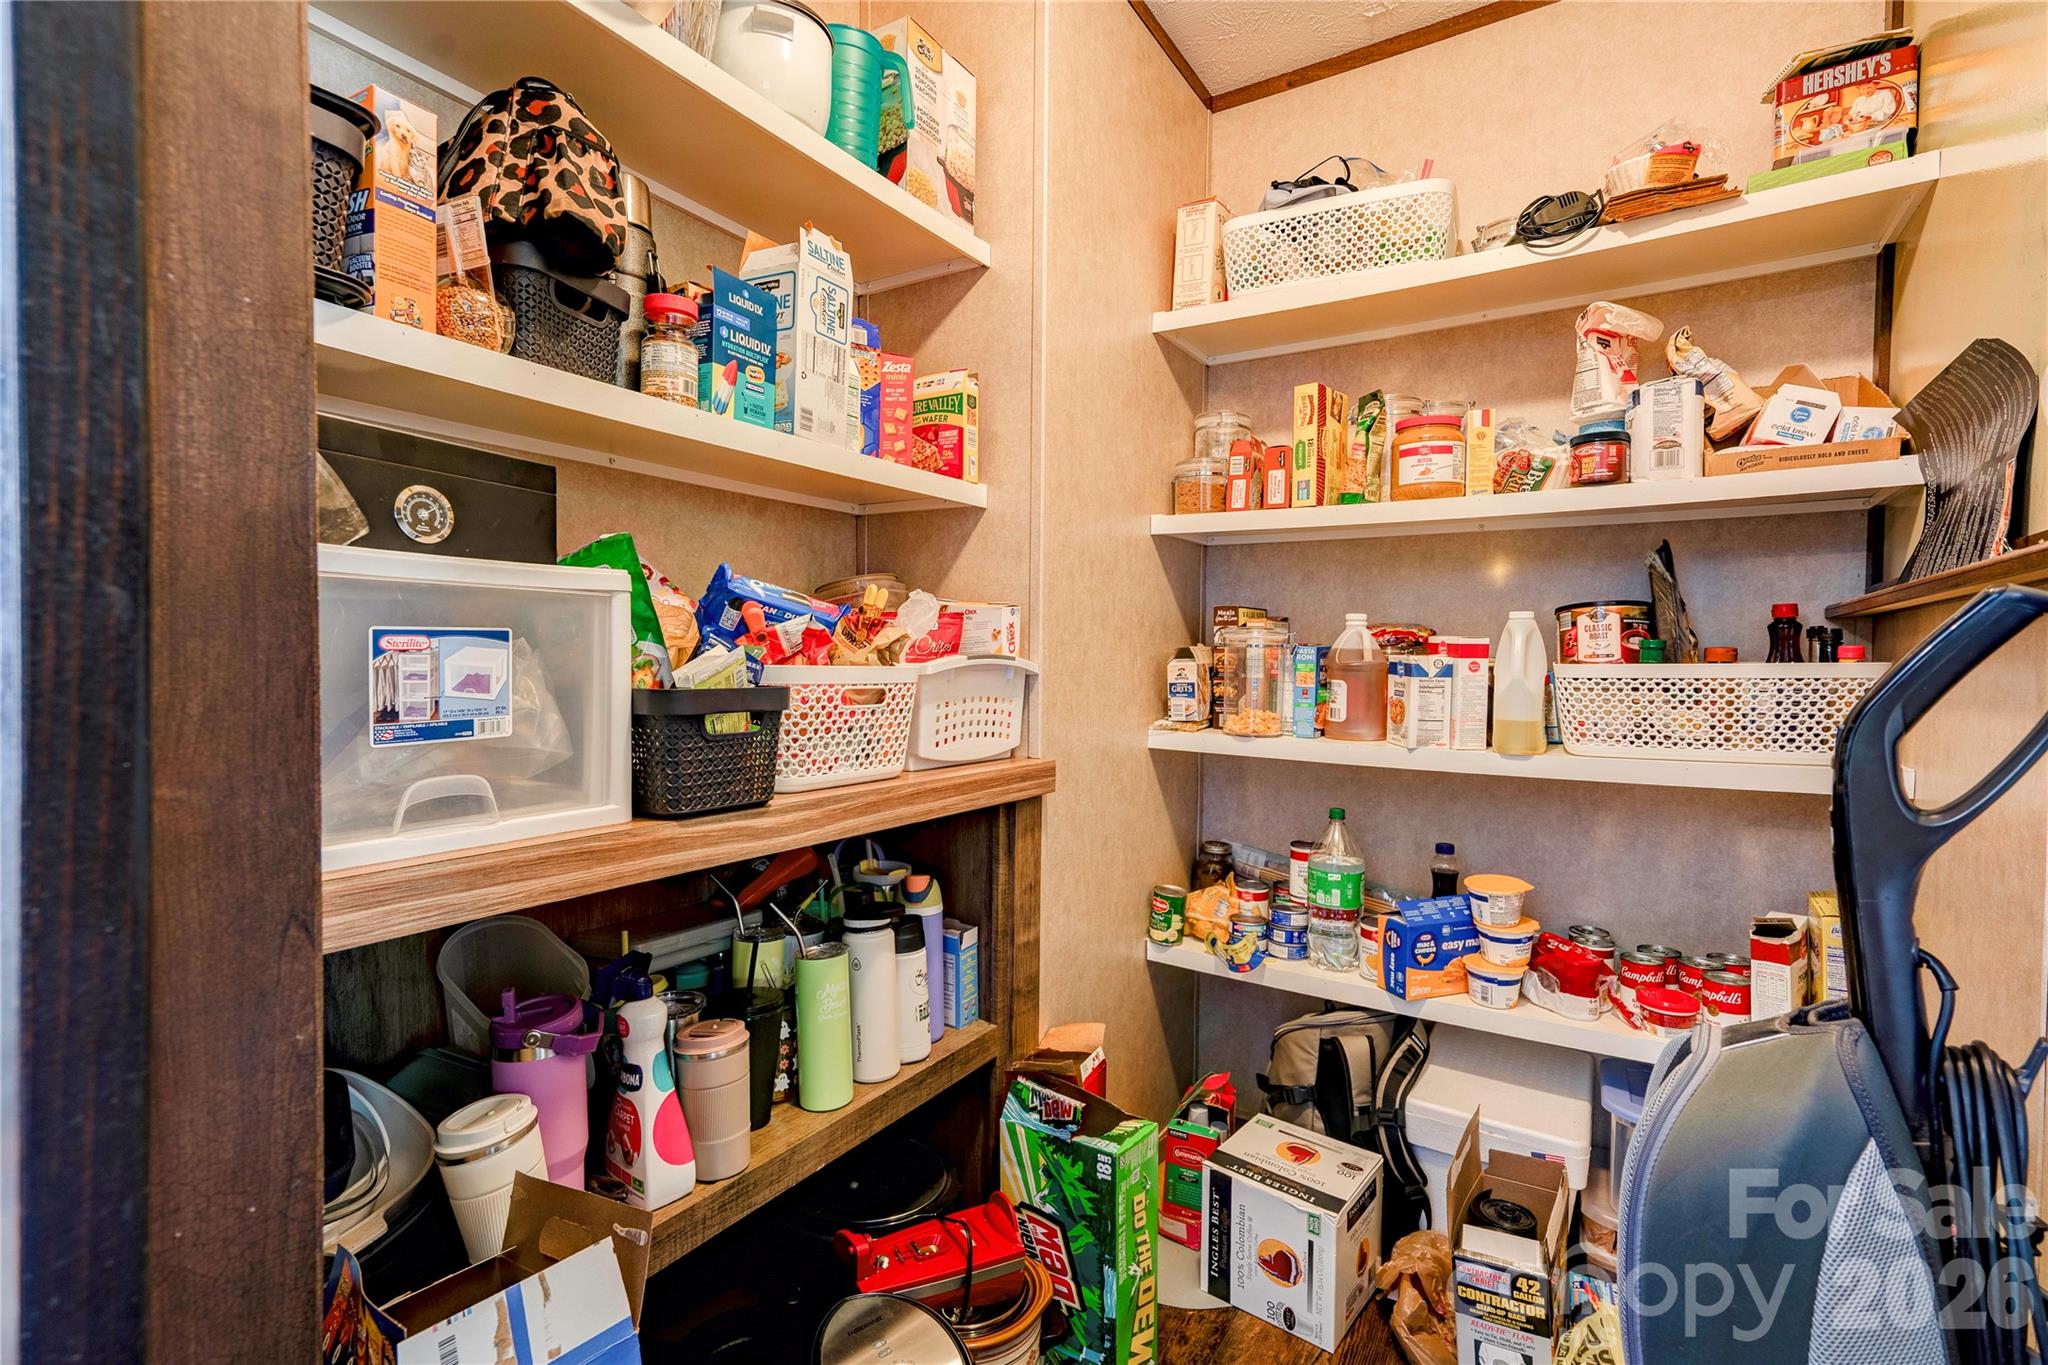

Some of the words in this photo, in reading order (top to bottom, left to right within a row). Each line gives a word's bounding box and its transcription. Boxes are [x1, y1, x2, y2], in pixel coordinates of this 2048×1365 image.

[1802, 52, 1892, 96] HERSHEY'S
[807, 240, 845, 271] SALTINE
[728, 292, 754, 312] LIQUID
[827, 286, 836, 337] SALTINE
[730, 329, 761, 352] LIQUID
[881, 361, 912, 373] Zesta
[929, 396, 961, 413] VALLEY
[922, 415, 949, 423] WAFER
[1771, 423, 1791, 432] cold
[1791, 427, 1816, 438] brew
[1584, 623, 1612, 632] CLASSIC
[1589, 632, 1608, 640] ROAST
[385, 638, 428, 648] Sterilite
[1007, 622, 1016, 654] Chex
[1171, 685, 1193, 693] GRITS
[1442, 940, 1464, 952] easy
[1465, 938, 1480, 947] ma
[1702, 988, 1742, 1004] mpbell's
[1230, 1164, 1262, 1182] BEST
[1243, 1151, 1297, 1178] Colombian
[1298, 1173, 1326, 1188] 100%
[1336, 1169, 1357, 1180] 100
[1263, 1178, 1316, 1203] INGLES
[1133, 1191, 1147, 1230] DO
[1211, 1193, 1219, 1225] BEST
[1236, 1204, 1246, 1261] Colombian
[1136, 1230, 1152, 1276] THE
[1211, 1228, 1219, 1277] INGLES
[1237, 1264, 1245, 1290] 100%
[1470, 1276, 1496, 1288] CHOICE
[1516, 1277, 1541, 1296] 42
[1457, 1286, 1546, 1319] CONTRACTOR
[1513, 1291, 1545, 1305] GALLON
[1267, 1301, 1276, 1321] 100
[1476, 1303, 1506, 1316] CLEAN-UP
[1508, 1310, 1527, 1322] BAGS
[1513, 1332, 1535, 1344] FLAPS
